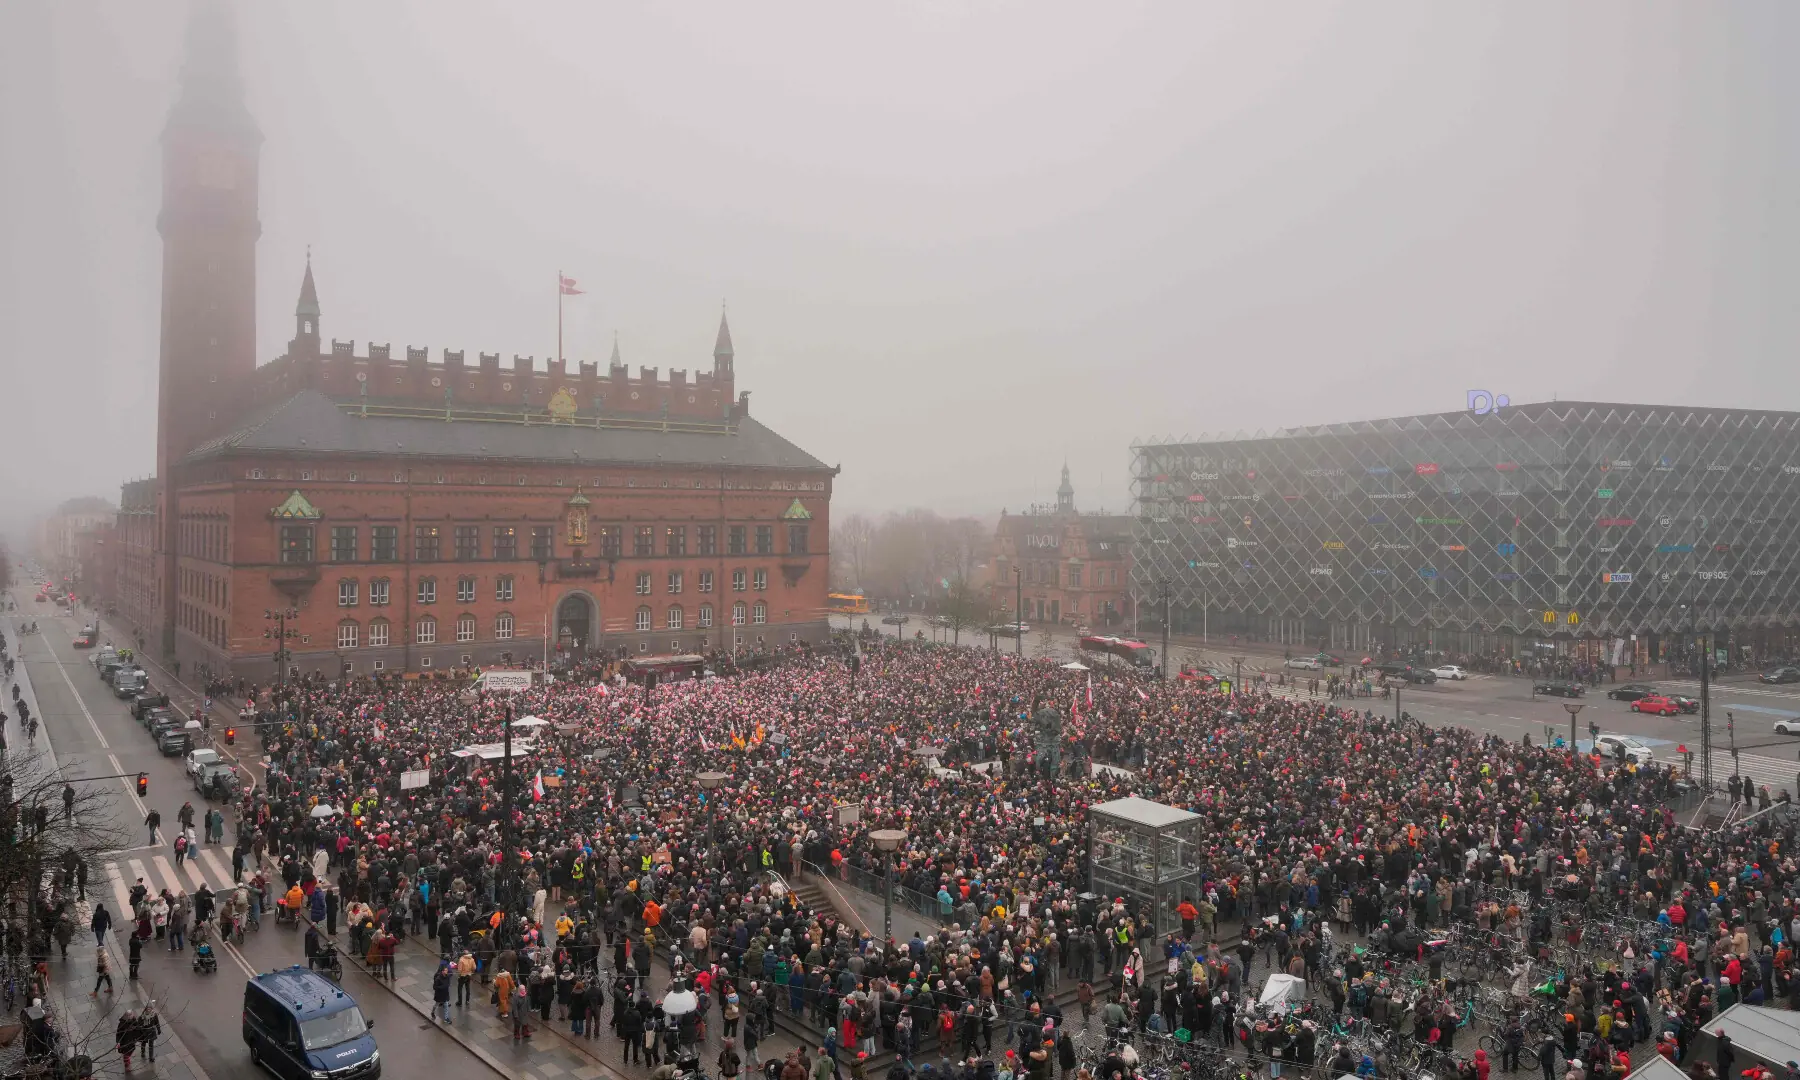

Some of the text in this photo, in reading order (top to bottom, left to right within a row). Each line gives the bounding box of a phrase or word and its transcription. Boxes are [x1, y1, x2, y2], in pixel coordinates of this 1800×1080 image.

[1310, 567, 1333, 575] KPMG
[1698, 571, 1728, 580] TOPSOE
[1611, 574, 1631, 583] STARK
[335, 1048, 358, 1059] POLITI
